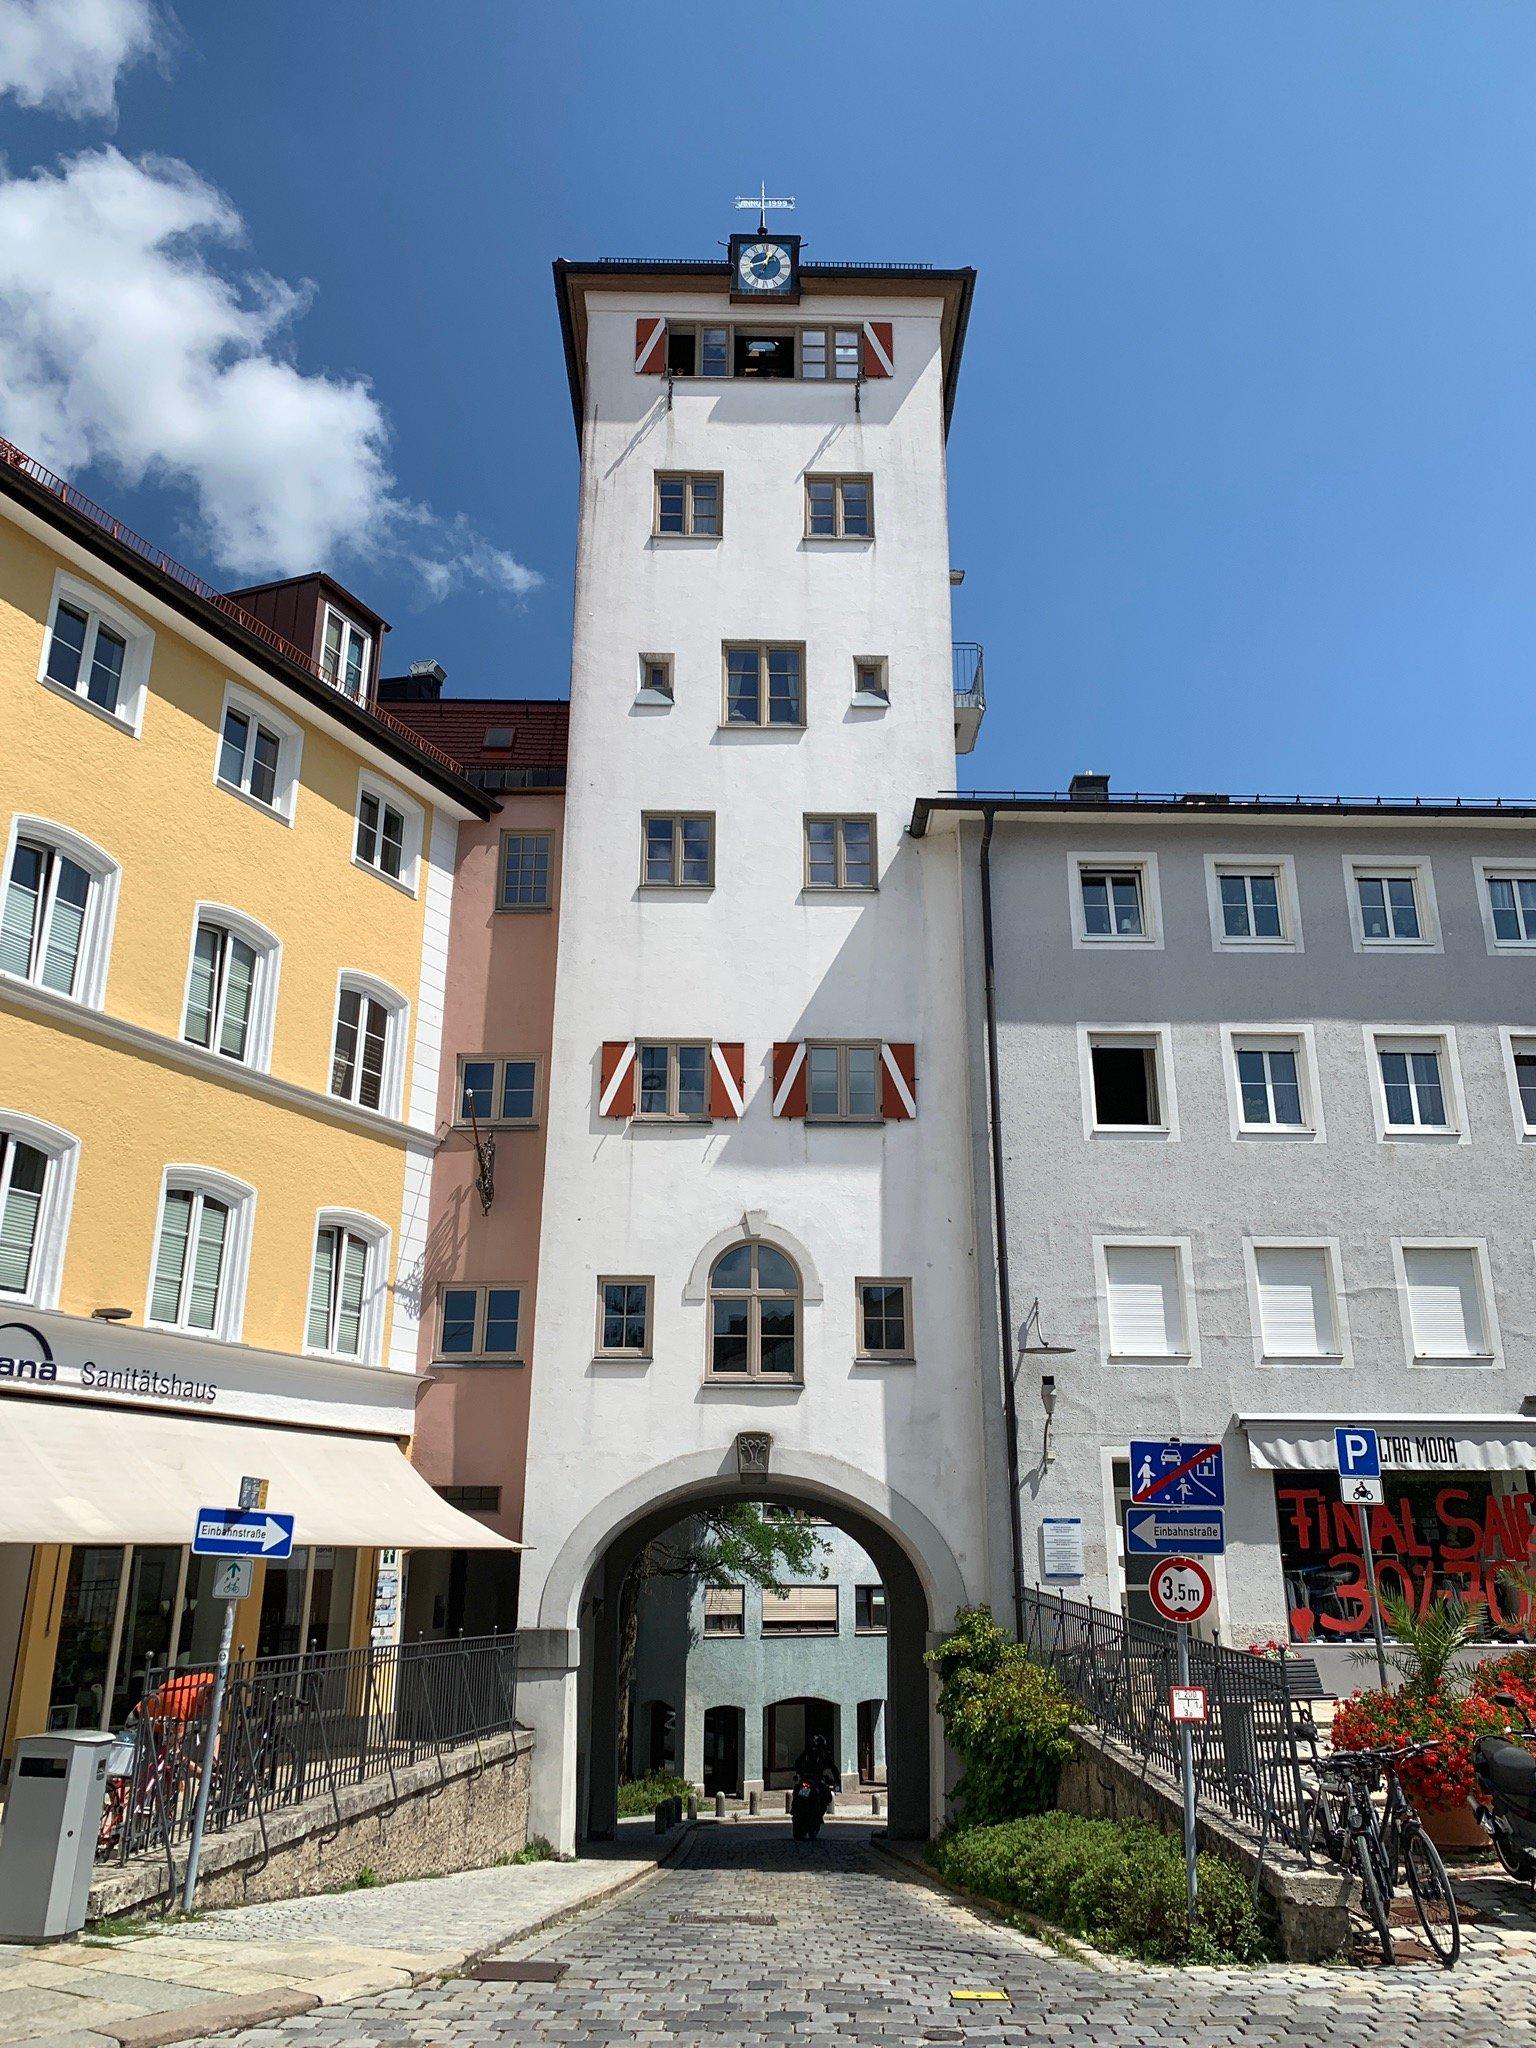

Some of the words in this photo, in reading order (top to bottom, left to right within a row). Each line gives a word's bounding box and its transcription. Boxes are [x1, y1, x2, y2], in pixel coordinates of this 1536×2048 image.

[82, 1361, 218, 1400] Sanitätshaus
[1345, 1434, 1368, 1470] P
[1378, 1436, 1413, 1463] LTRA
[1415, 1436, 1458, 1463] MODA
[201, 1524, 267, 1540] Einbahnstraße
[1154, 1525, 1218, 1537] Einbahnstraße
[1162, 1575, 1200, 1602] 3,5m
